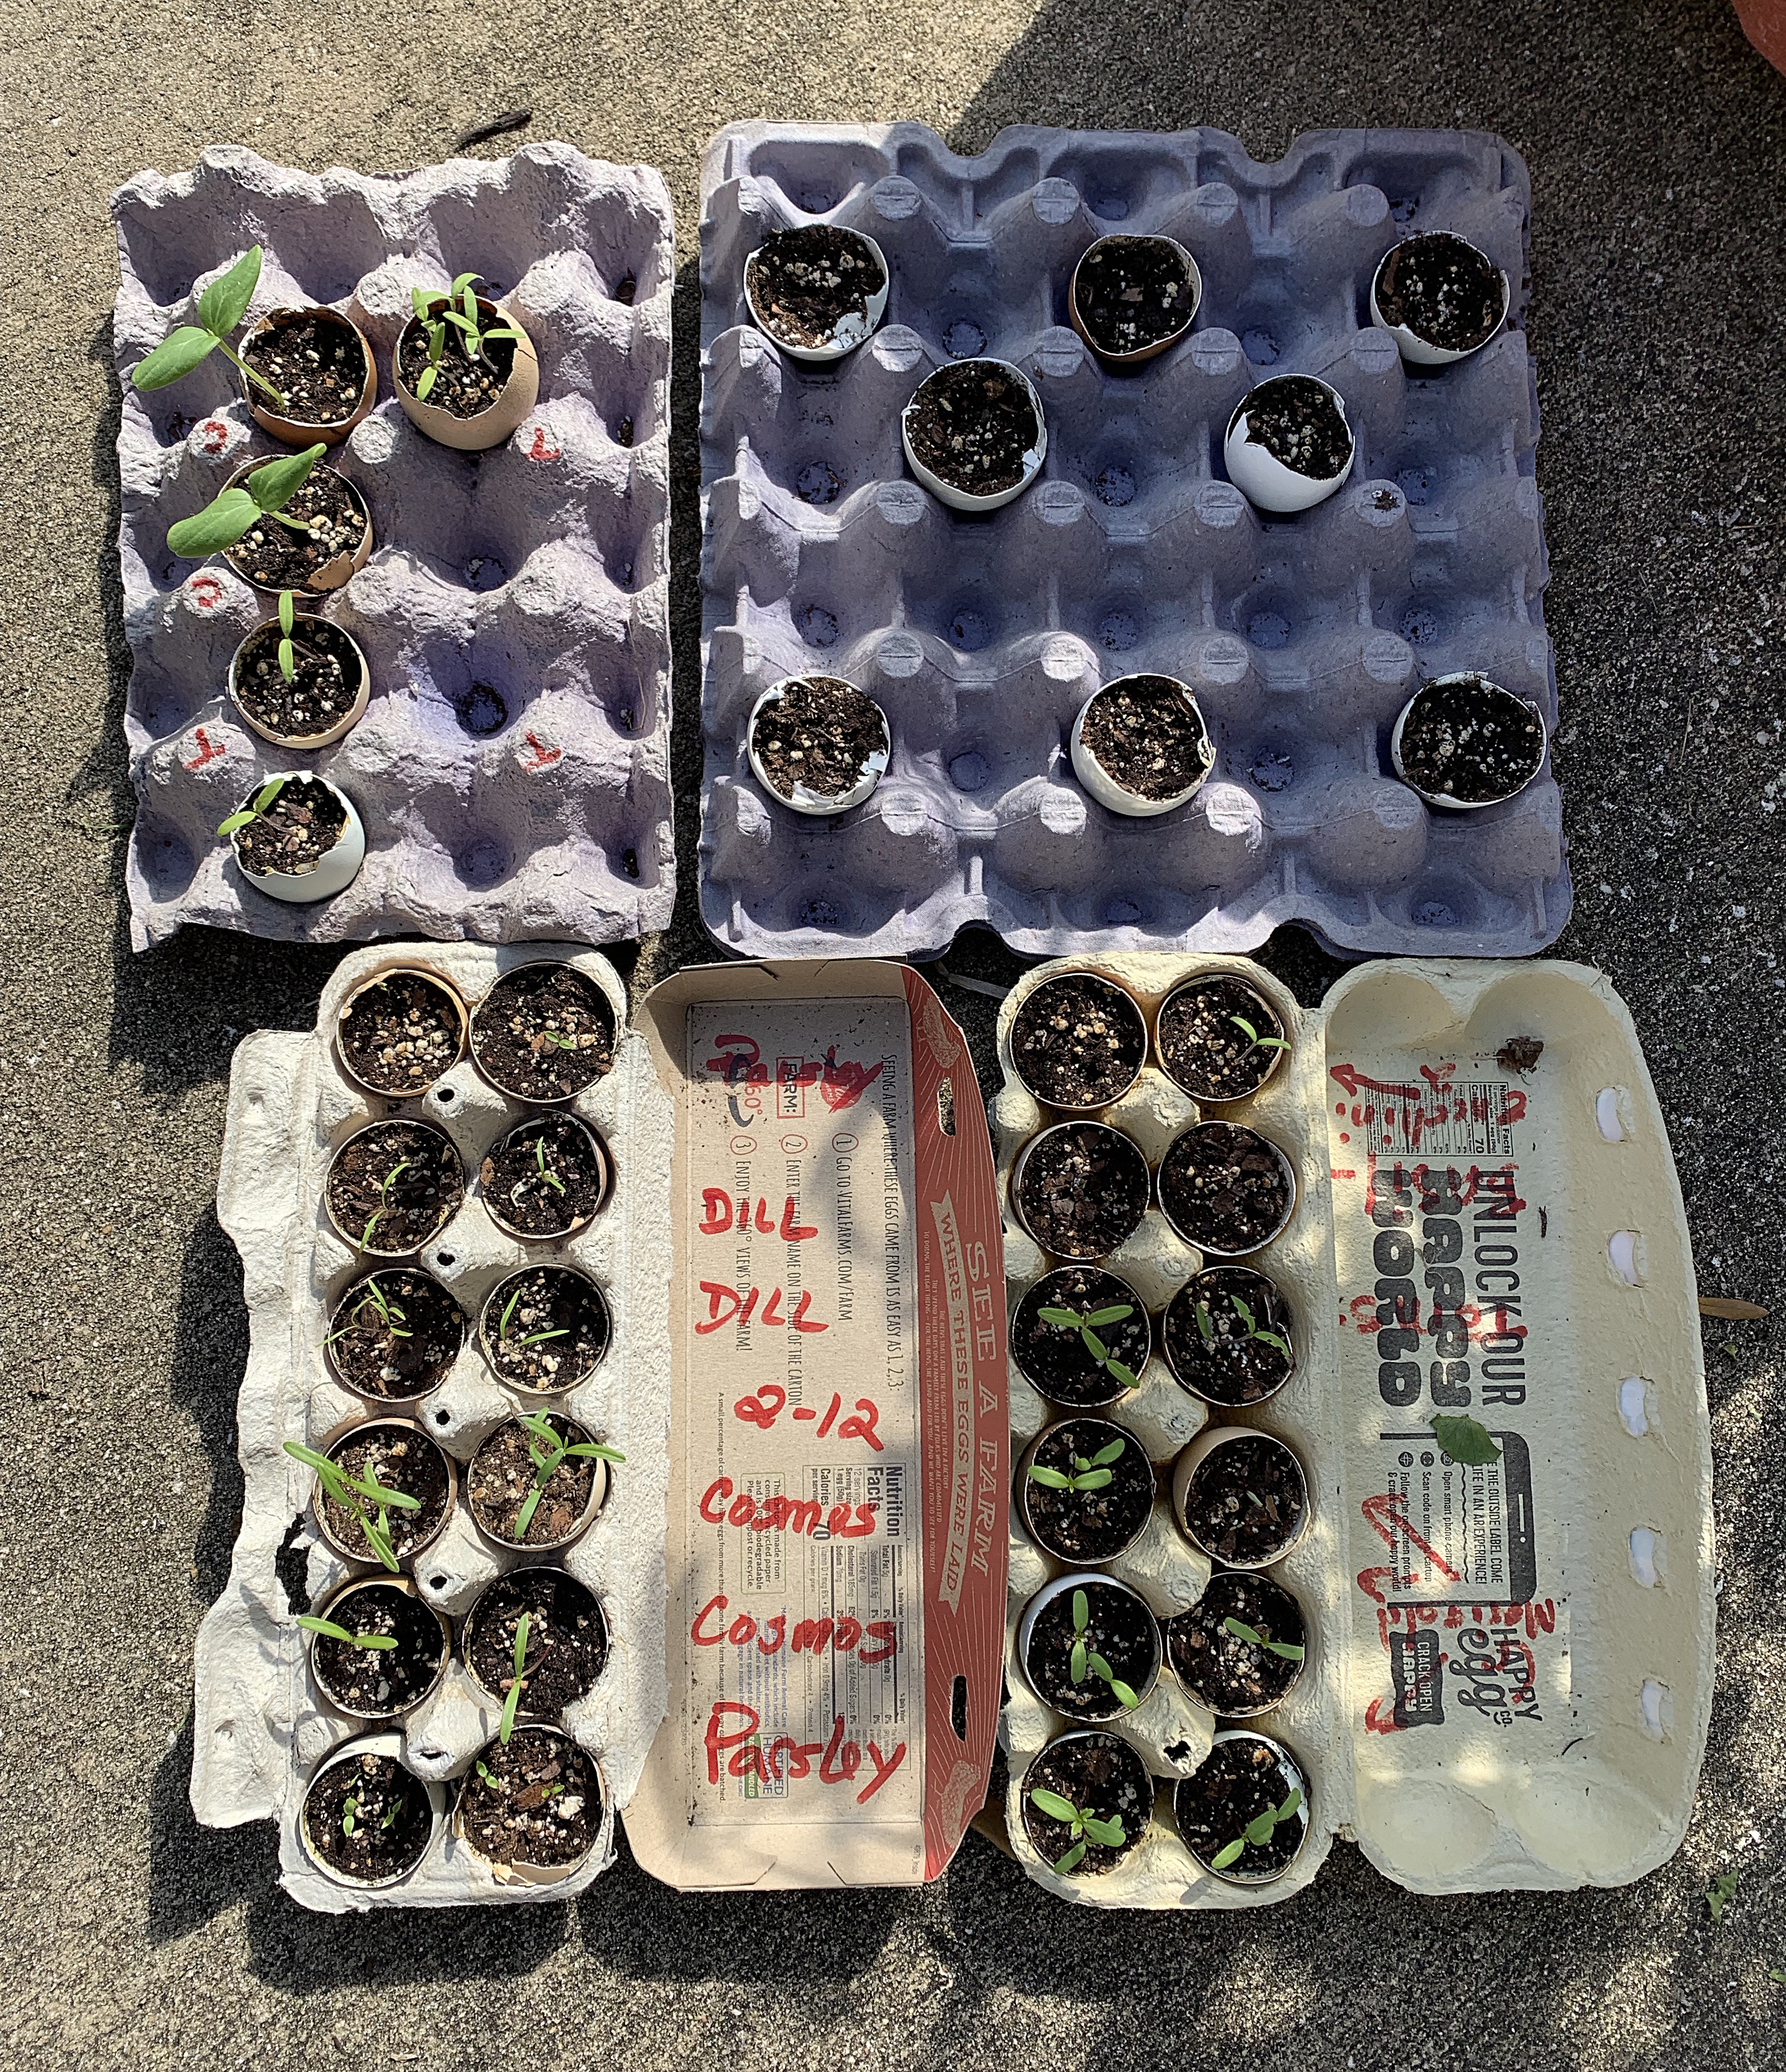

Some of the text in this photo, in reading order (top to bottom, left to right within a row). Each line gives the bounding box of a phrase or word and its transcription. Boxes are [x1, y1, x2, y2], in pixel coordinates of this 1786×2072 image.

[744, 1080, 762, 1115] 60°
[781, 1063, 798, 1112] FARM:
[881, 1103, 897, 1129] FARM
[1498, 1085, 1510, 1154] Nutrition Facts
[882, 1133, 898, 1163] WHERE
[1474, 1138, 1484, 1153] 70
[836, 1176, 852, 1187] TO
[884, 1167, 898, 1192] THESE
[735, 1197, 751, 1212] THE
[785, 1192, 801, 1207] THE
[884, 1196, 899, 1220] EGGS
[699, 1187, 819, 1242] DILL
[884, 1223, 899, 1251] CAME
[735, 1247, 752, 1278] VIEWS
[786, 1239, 802, 1268] NAME
[786, 1272, 802, 1287] ON
[884, 1255, 900, 1283] FROM
[735, 1283, 752, 1295] OF
[786, 1292, 802, 1306] THE
[886, 1287, 901, 1297] IS
[1371, 1170, 1422, 1407] WORLD
[1420, 1170, 1471, 1408] HAPPY
[1472, 1170, 1526, 1405] UNLOCK OUR
[695, 1280, 830, 1334] DILL
[886, 1300, 901, 1311] AS
[786, 1311, 802, 1331] SIDE
[887, 1315, 901, 1337] EASY
[735, 1320, 752, 1351] FARM!
[786, 1335, 802, 1346] OF
[887, 1340, 901, 1352] AS
[787, 1350, 802, 1365] THE
[885, 1355, 903, 1364] 1,
[787, 1369, 803, 1405] CARTON
[887, 1380, 904, 1391] 3:
[940, 1212, 969, 1591] WHERE THESE EGGS WERE LAID
[964, 1241, 998, 1577] SEE A FARM
[715, 1418, 725, 1456] percentage
[755, 1480, 764, 1495] and
[773, 1480, 781, 1495] This
[835, 1472, 843, 1484] egg
[844, 1468, 853, 1491] Serving
[867, 1467, 884, 1512] Facts
[1400, 1472, 1410, 1499] Follow
[1422, 1471, 1431, 1490] Scan
[1442, 1471, 1452, 1490] Open
[1487, 1470, 1499, 1486] THE
[810, 1480, 819, 1503] serving
[835, 1486, 845, 1502] (50g)
[852, 1477, 862, 1506] servings
[885, 1466, 903, 1537] Nutrition
[1387, 1480, 1398, 1502] crack
[1422, 1493, 1432, 1512] code
[700, 1477, 877, 1538] Cosmos
[773, 1497, 781, 1524] carton
[811, 1469, 831, 1541] Calories 70
[1386, 1504, 1397, 1523] open
[1400, 1500, 1410, 1513] the
[1442, 1493, 1452, 1515] smart
[1487, 1489, 1500, 1525] OUTSIDE
[1423, 1515, 1430, 1523] on
[1442, 1518, 1453, 1541] phone
[1471, 1465, 1487, 1584] LIFE IN AN AR EXPERIENCE!
[715, 1525, 724, 1541] eggs
[763, 1522, 773, 1557] recycled
[1389, 1525, 1398, 1539] our
[1423, 1526, 1432, 1544] front
[1488, 1528, 1503, 1555] LABEL
[746, 1546, 752, 1555] or
[773, 1534, 781, 1557] made
[1388, 1540, 1400, 1565] happy
[754, 1529, 764, 1590] biodegradable
[762, 1559, 771, 1583] paper
[773, 1559, 781, 1580] from
[1423, 1557, 1433, 1582] carton
[1490, 1558, 1504, 1583] COME
[745, 1557, 754, 1588] recycle.
[1391, 1567, 1401, 1592] world!
[1400, 1557, 1412, 1590] prompts
[692, 1594, 896, 1663] Cosmos
[1416, 1642, 1433, 1712] CRACK OPEN
[1448, 1628, 1507, 1717] egg
[1499, 1711, 1513, 1727] CO.
[1490, 1628, 1544, 1722] HAPPY
[705, 1701, 905, 1805] Parsley
[762, 1737, 773, 1794] HUMANE
[773, 1735, 784, 1794] CERTIFIED
